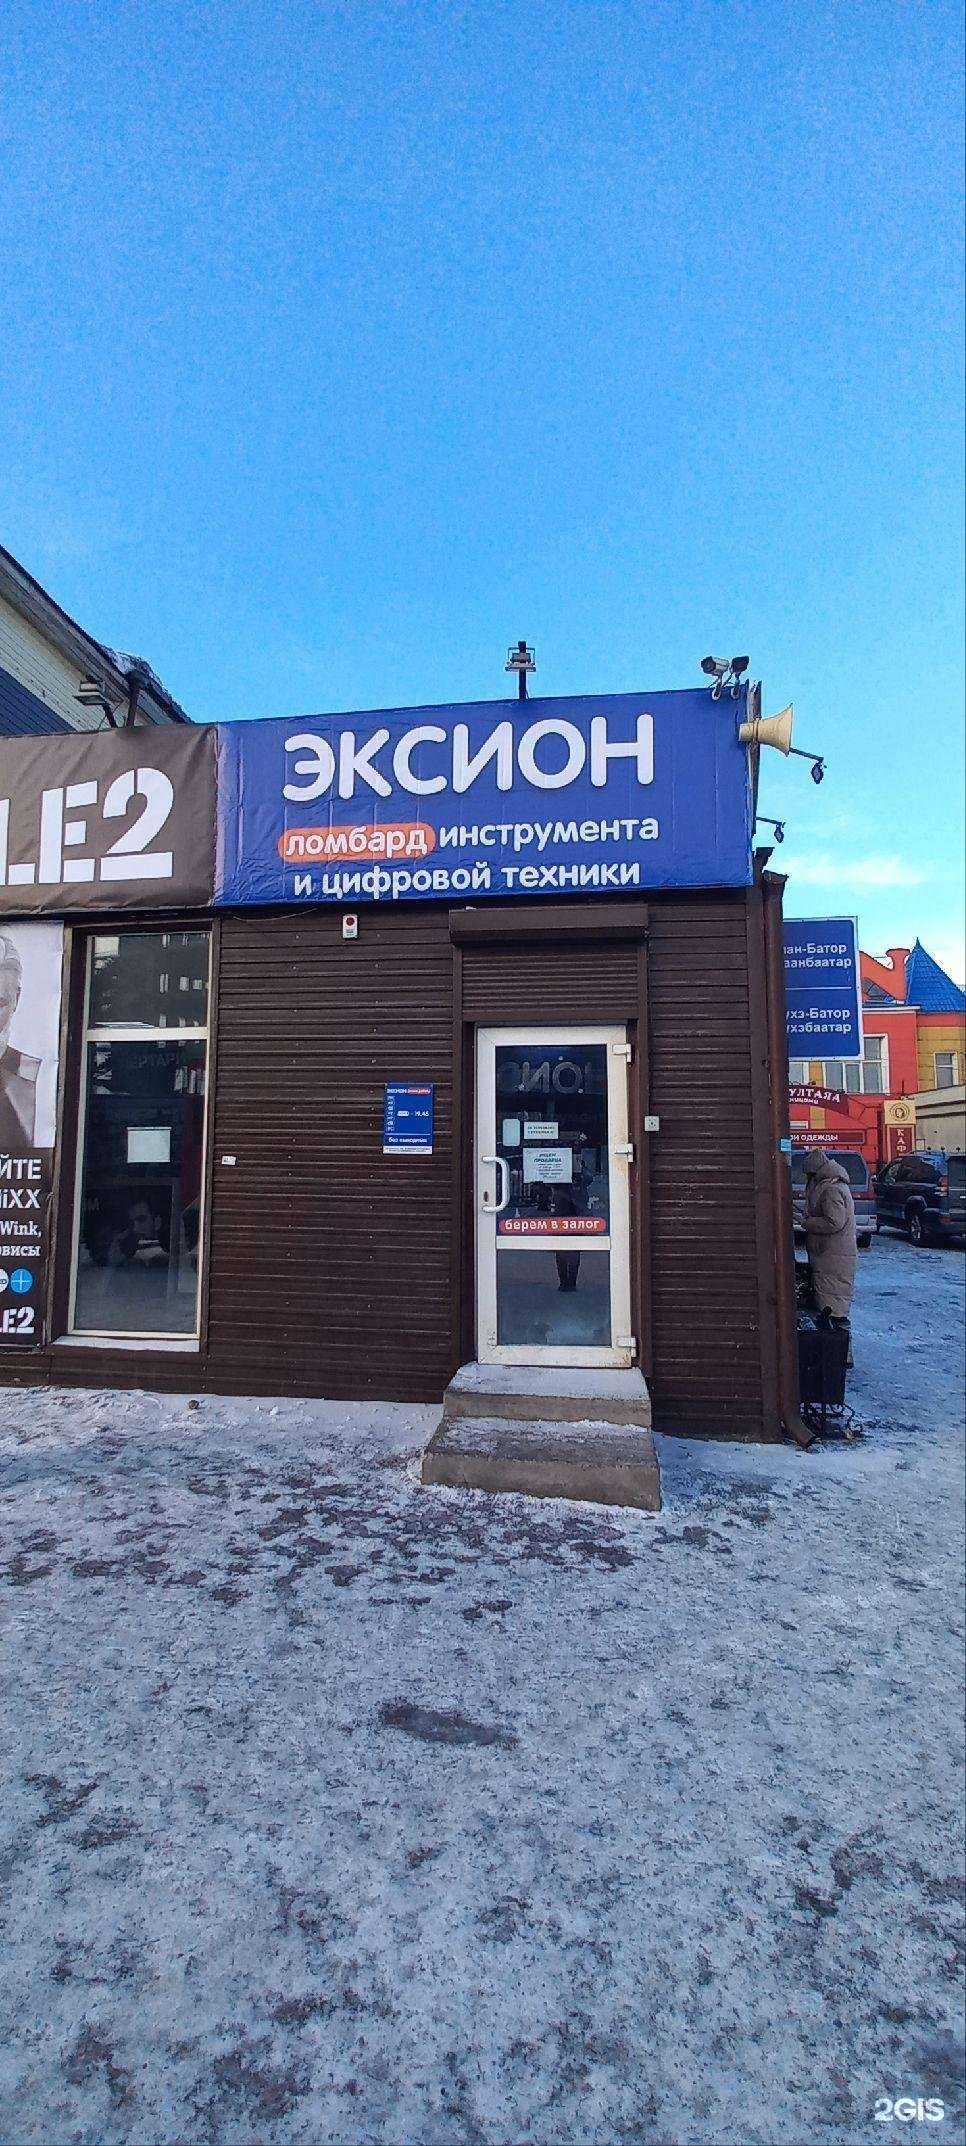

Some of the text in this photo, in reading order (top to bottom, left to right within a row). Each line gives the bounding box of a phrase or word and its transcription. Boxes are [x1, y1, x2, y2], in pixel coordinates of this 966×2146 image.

[282, 714, 654, 802] ЭКСИОН
[285, 816, 659, 858] ломбард инструмента
[294, 860, 640, 899] и цифровой техники
[801, 1134, 839, 1142] ОДЕЖДЫ
[0, 1188, 41, 1209] iXX
[505, 1219, 600, 1232] берем в залог
[0, 1245, 41, 1257] висы
[0, 1306, 35, 1334] E2
